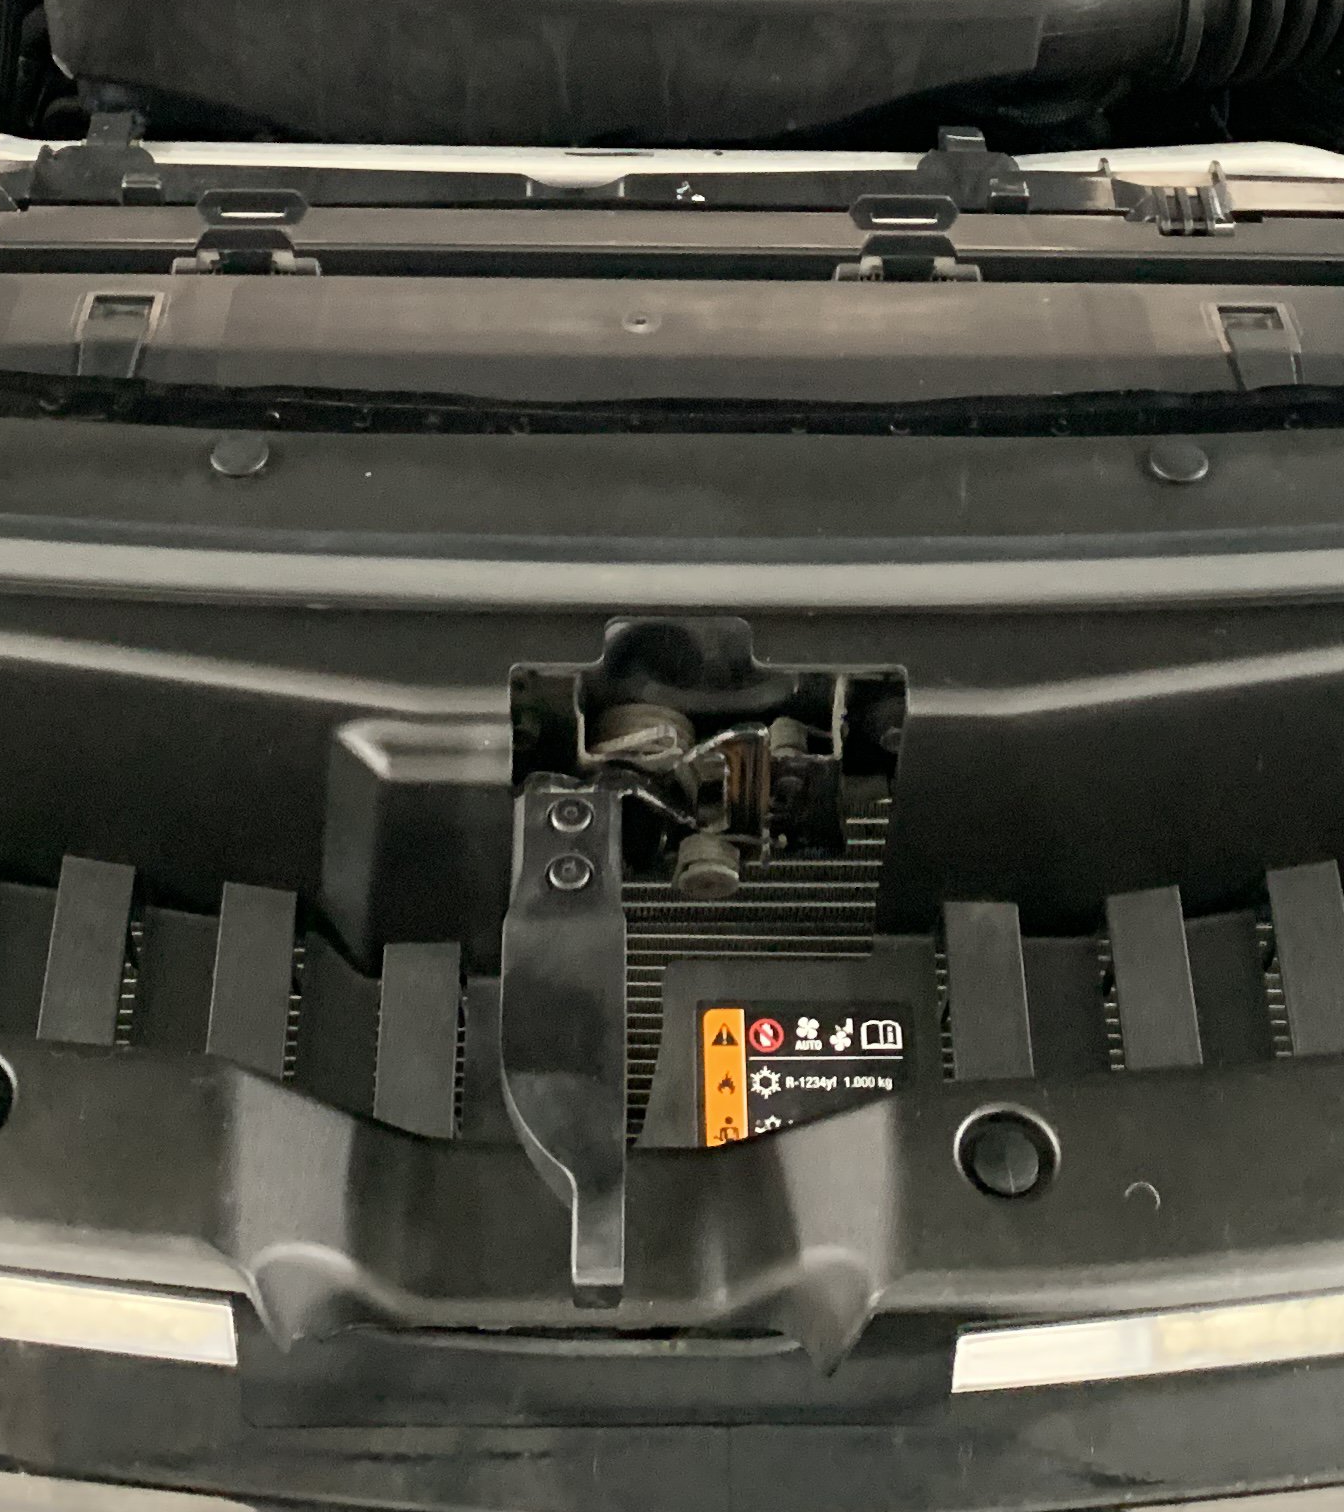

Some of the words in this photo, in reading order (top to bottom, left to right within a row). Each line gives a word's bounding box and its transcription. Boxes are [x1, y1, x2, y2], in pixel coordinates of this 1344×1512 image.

[795, 1039, 823, 1051] AUTO
[785, 1076, 838, 1092] R-1234yf
[843, 1076, 876, 1089] 1.000
[877, 1076, 894, 1091] kg
